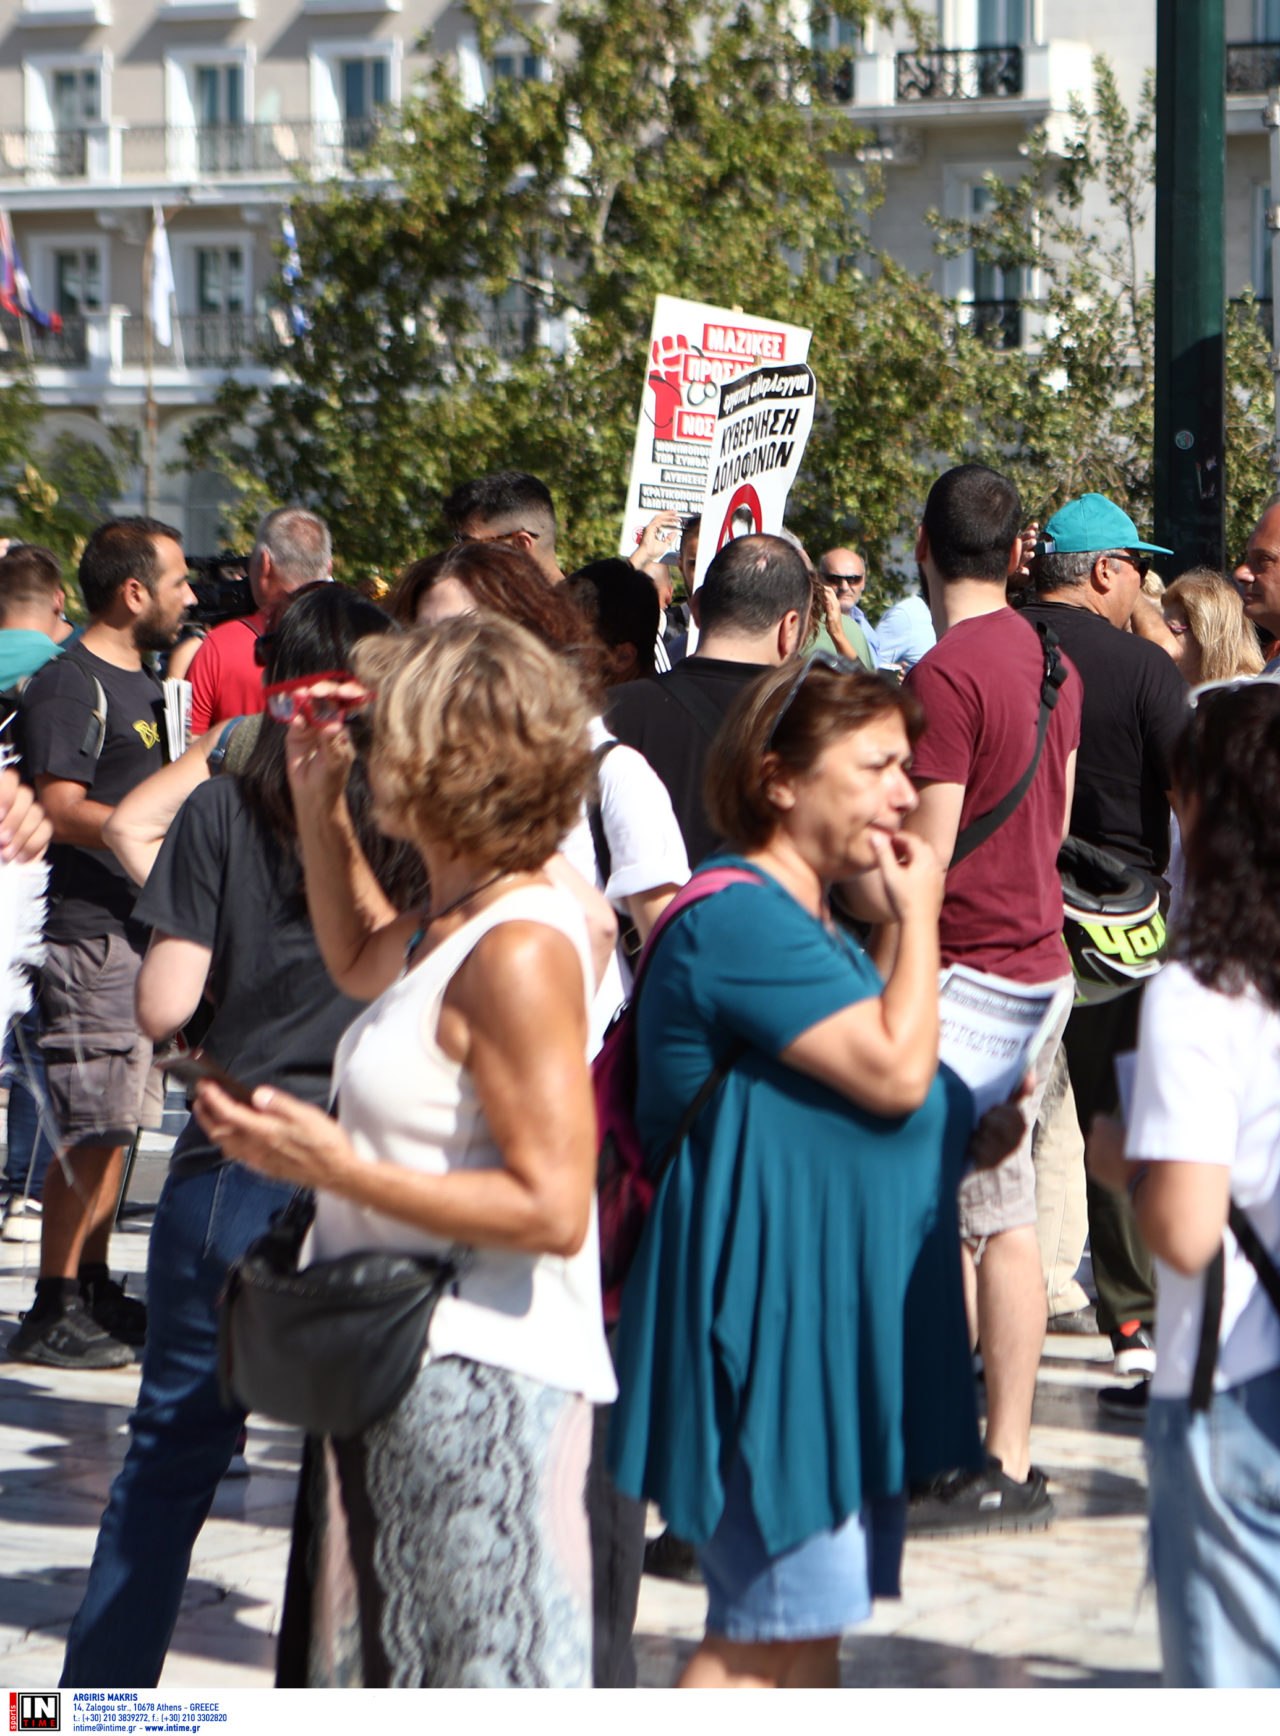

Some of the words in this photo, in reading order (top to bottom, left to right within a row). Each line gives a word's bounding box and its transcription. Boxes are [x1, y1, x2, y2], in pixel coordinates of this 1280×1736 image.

[706, 326, 783, 358] ΜΑΖΙΚΕΣ
[682, 413, 714, 437] ΝΟΣ
[720, 408, 800, 458] ΚΥΒΕΡΝΗΣΗ
[712, 441, 795, 496] ΔΟΛΟΦΟΝΩΝ
